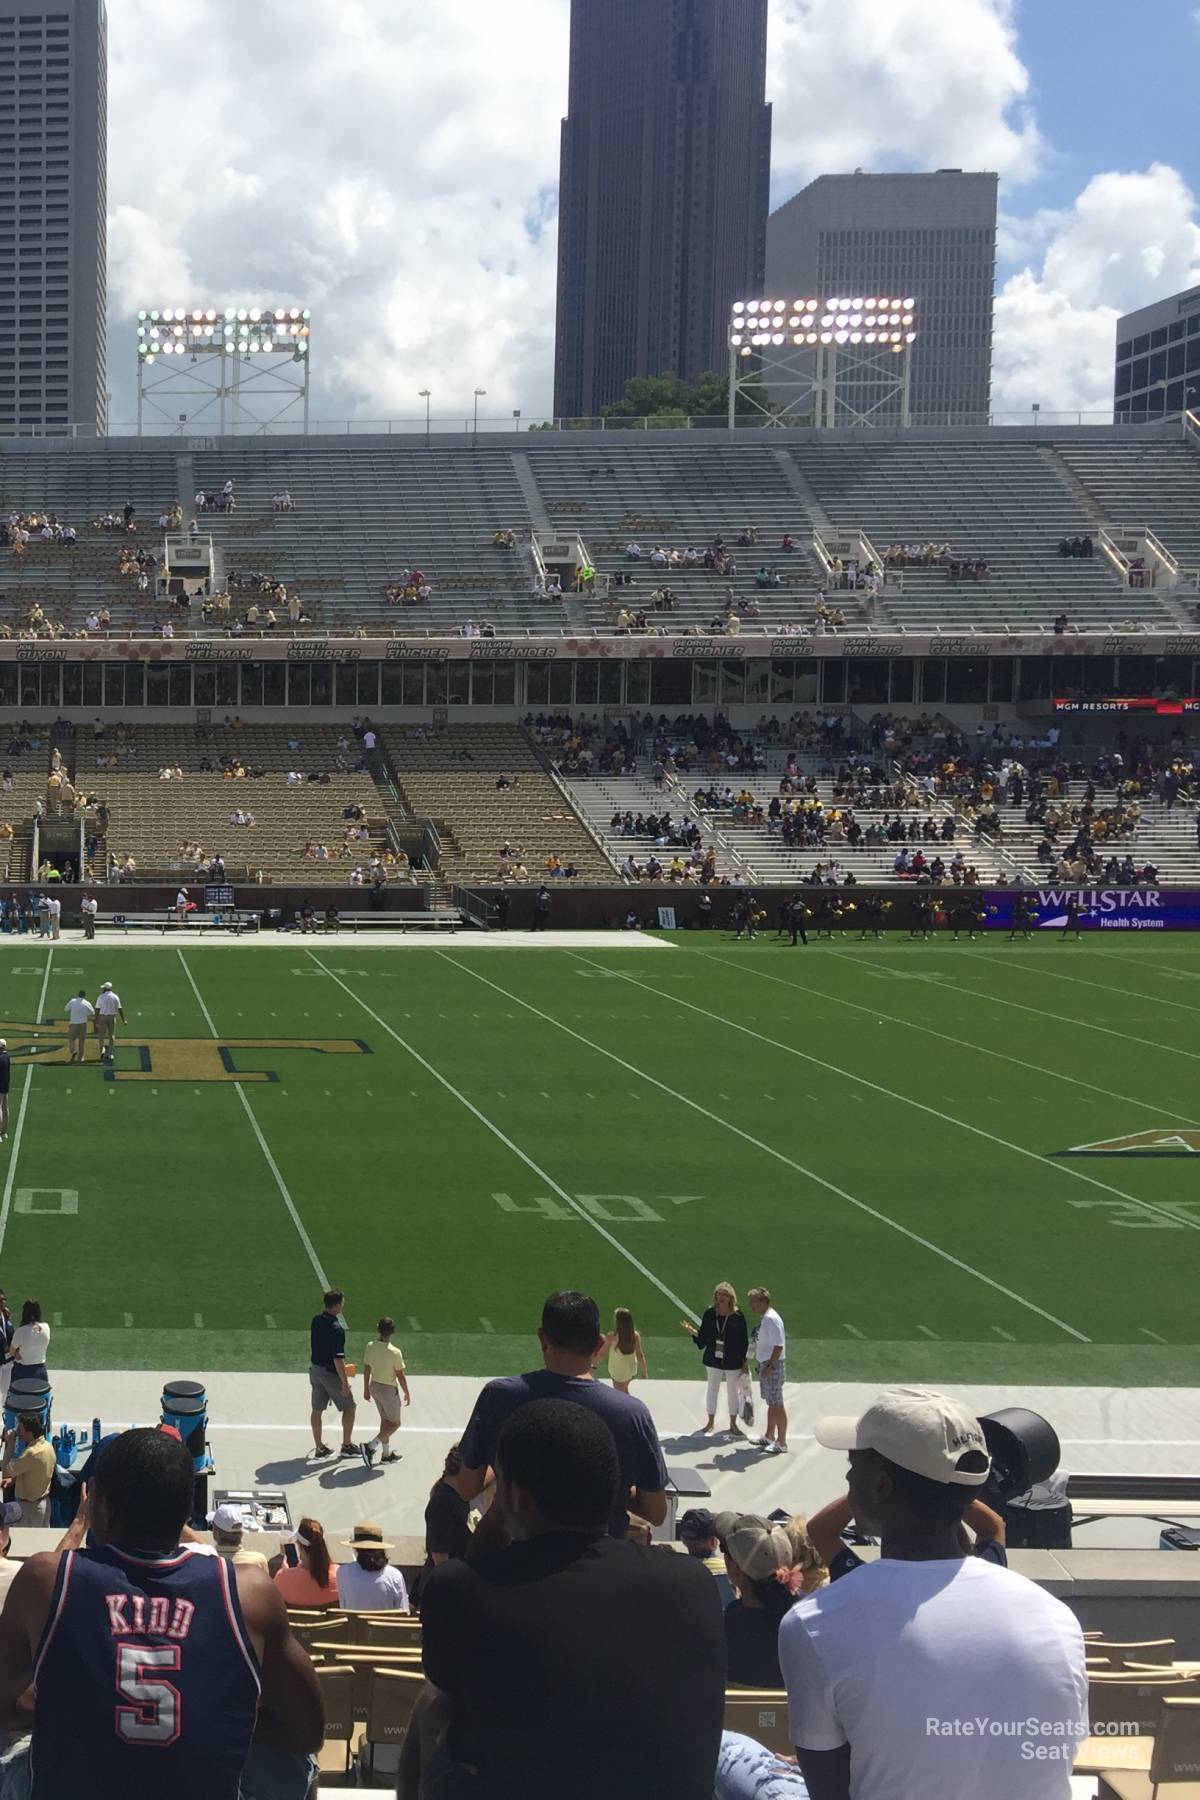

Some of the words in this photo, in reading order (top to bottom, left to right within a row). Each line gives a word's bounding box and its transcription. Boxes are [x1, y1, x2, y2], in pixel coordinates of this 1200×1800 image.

[185, 642, 212, 650] JOHN
[287, 642, 328, 650] EVERETT
[471, 641, 513, 649] WILLIAM
[674, 639, 713, 647] GEORGE
[772, 638, 805, 646] BOBBY
[844, 638, 877, 646] LARRY
[386, 649, 449, 659] FINCHER
[470, 649, 555, 658] ALEXANDER
[673, 647, 744, 657] GARDNER
[771, 646, 813, 656] DODD
[843, 646, 902, 656] MORRIS
[930, 645, 990, 655] GASTON
[1103, 645, 1144, 654] BECK
[17, 650, 66, 660] GUYON
[185, 650, 252, 660] HEISMAN
[287, 650, 361, 660] STRUPPER
[1082, 702, 1129, 710] RESORTS
[1101, 917, 1130, 927] Health
[1132, 918, 1164, 929] System
[490, 1193, 666, 1221] 40
[105, 1594, 196, 1639] KIDD
[114, 1642, 181, 1747] 5
